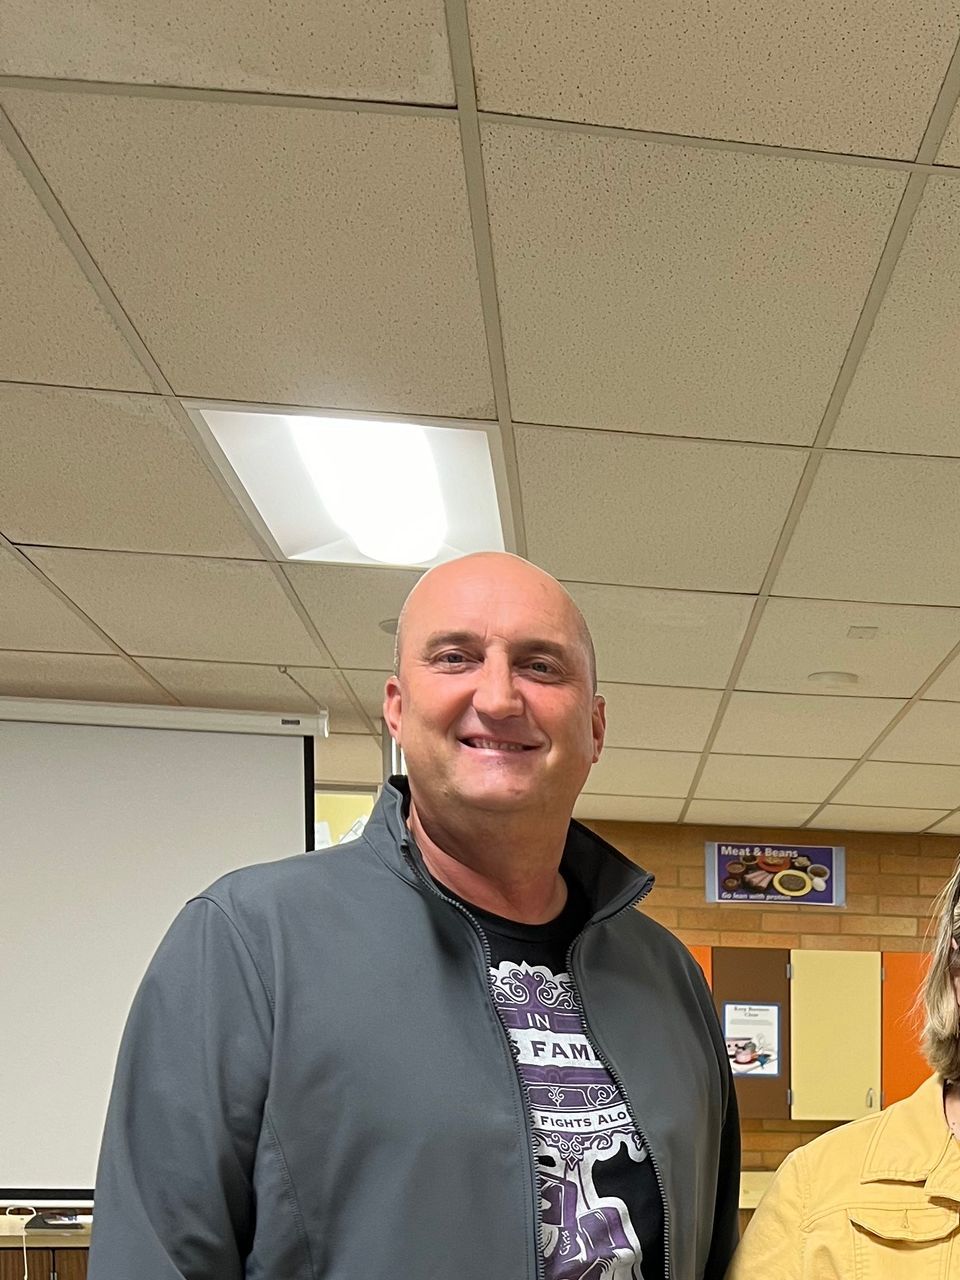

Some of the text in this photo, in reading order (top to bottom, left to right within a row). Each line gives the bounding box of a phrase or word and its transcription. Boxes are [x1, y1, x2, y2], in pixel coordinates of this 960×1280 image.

[721, 846, 798, 857] Meat & Beans
[527, 1012, 550, 1029] IN
[540, 1111, 627, 1127] FIGHTS ALO
